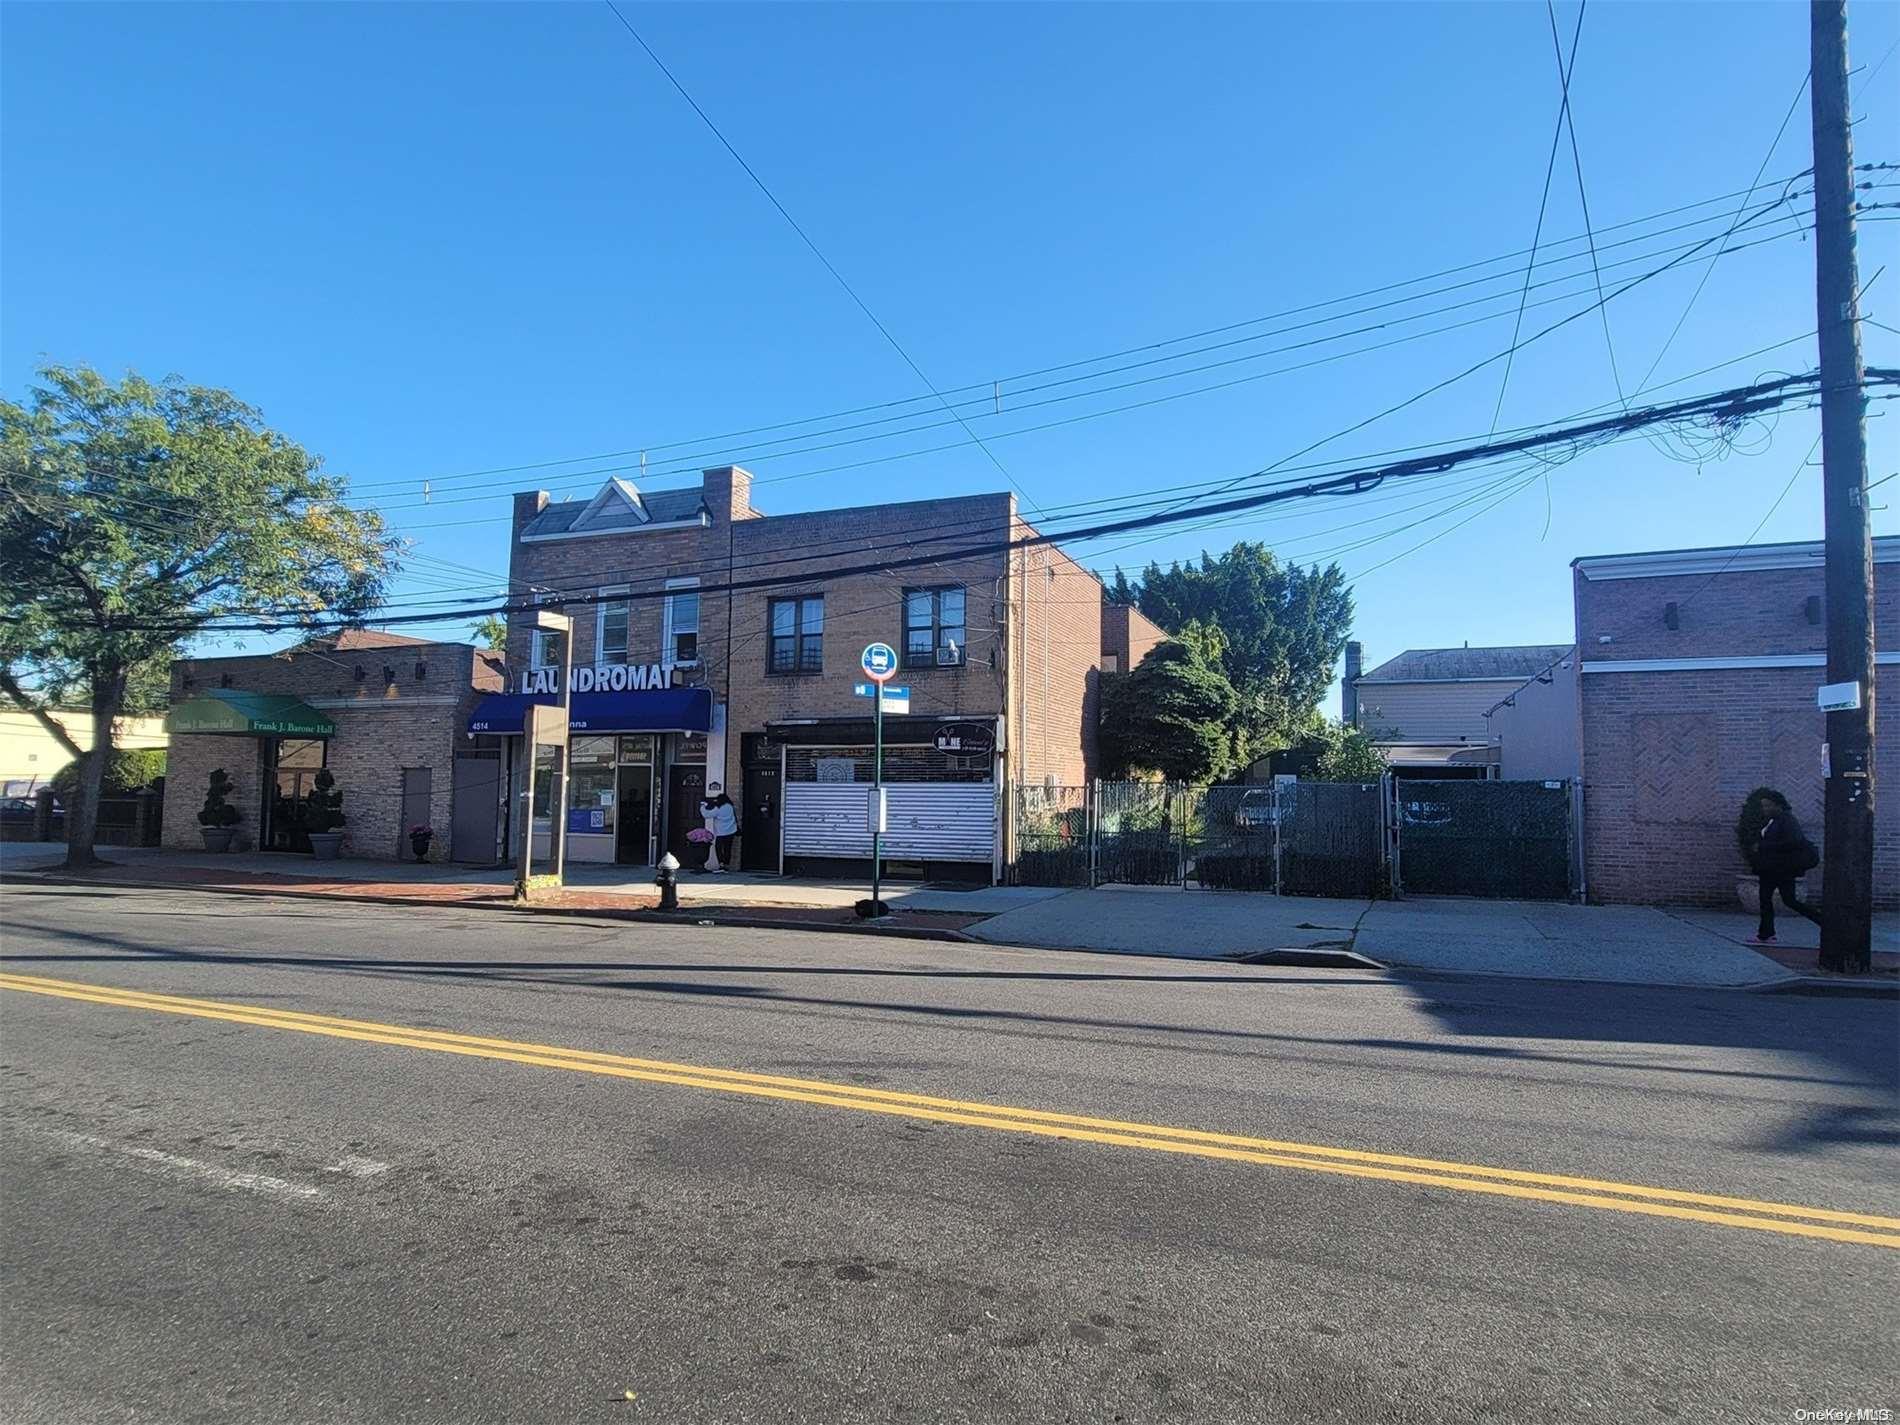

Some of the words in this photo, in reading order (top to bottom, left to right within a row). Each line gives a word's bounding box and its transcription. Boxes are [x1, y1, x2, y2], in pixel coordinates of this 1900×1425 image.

[253, 721, 278, 730] Frank
[316, 724, 333, 734] Hall
[472, 721, 489, 730] 4514
